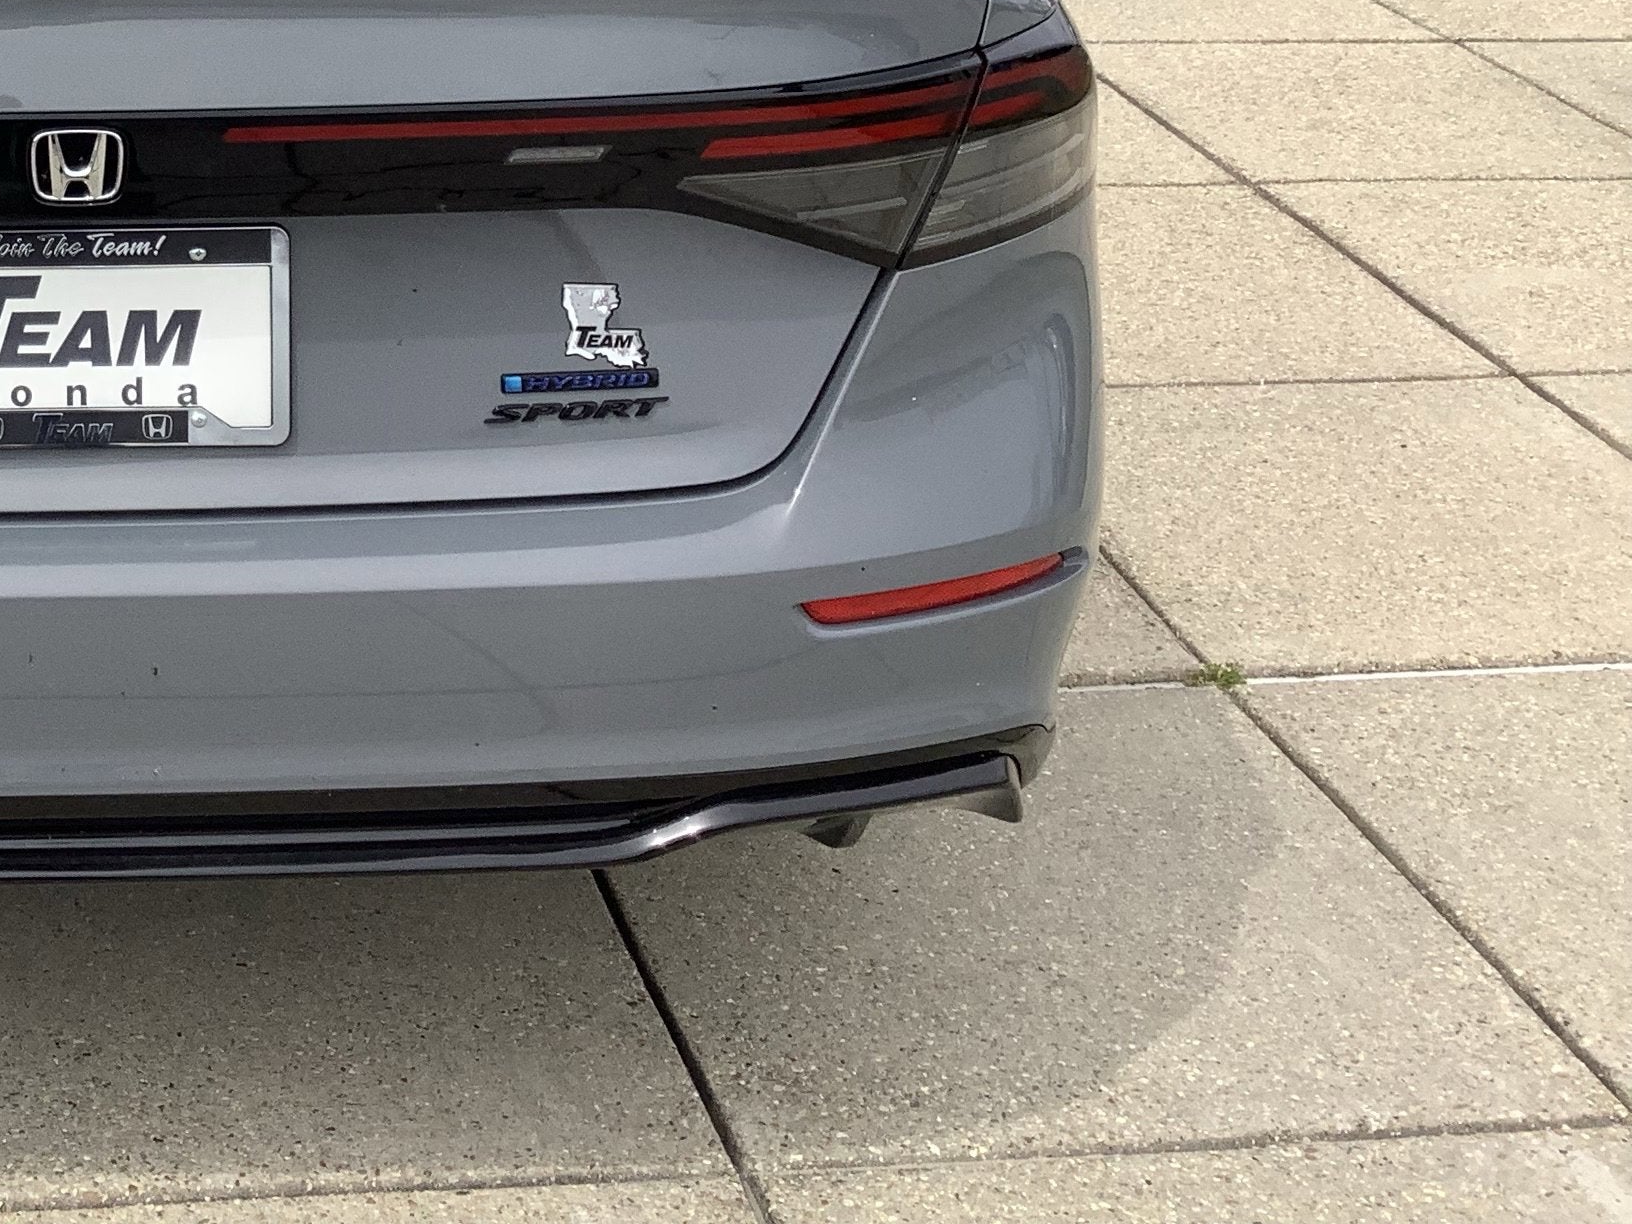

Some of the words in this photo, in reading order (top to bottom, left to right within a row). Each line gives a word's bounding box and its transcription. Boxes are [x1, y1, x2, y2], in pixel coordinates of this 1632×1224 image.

[37, 233, 84, 259] The
[87, 232, 167, 259] Team!
[576, 325, 634, 348] TEAM
[525, 372, 651, 391] HYBRID
[483, 396, 670, 425] SPORT
